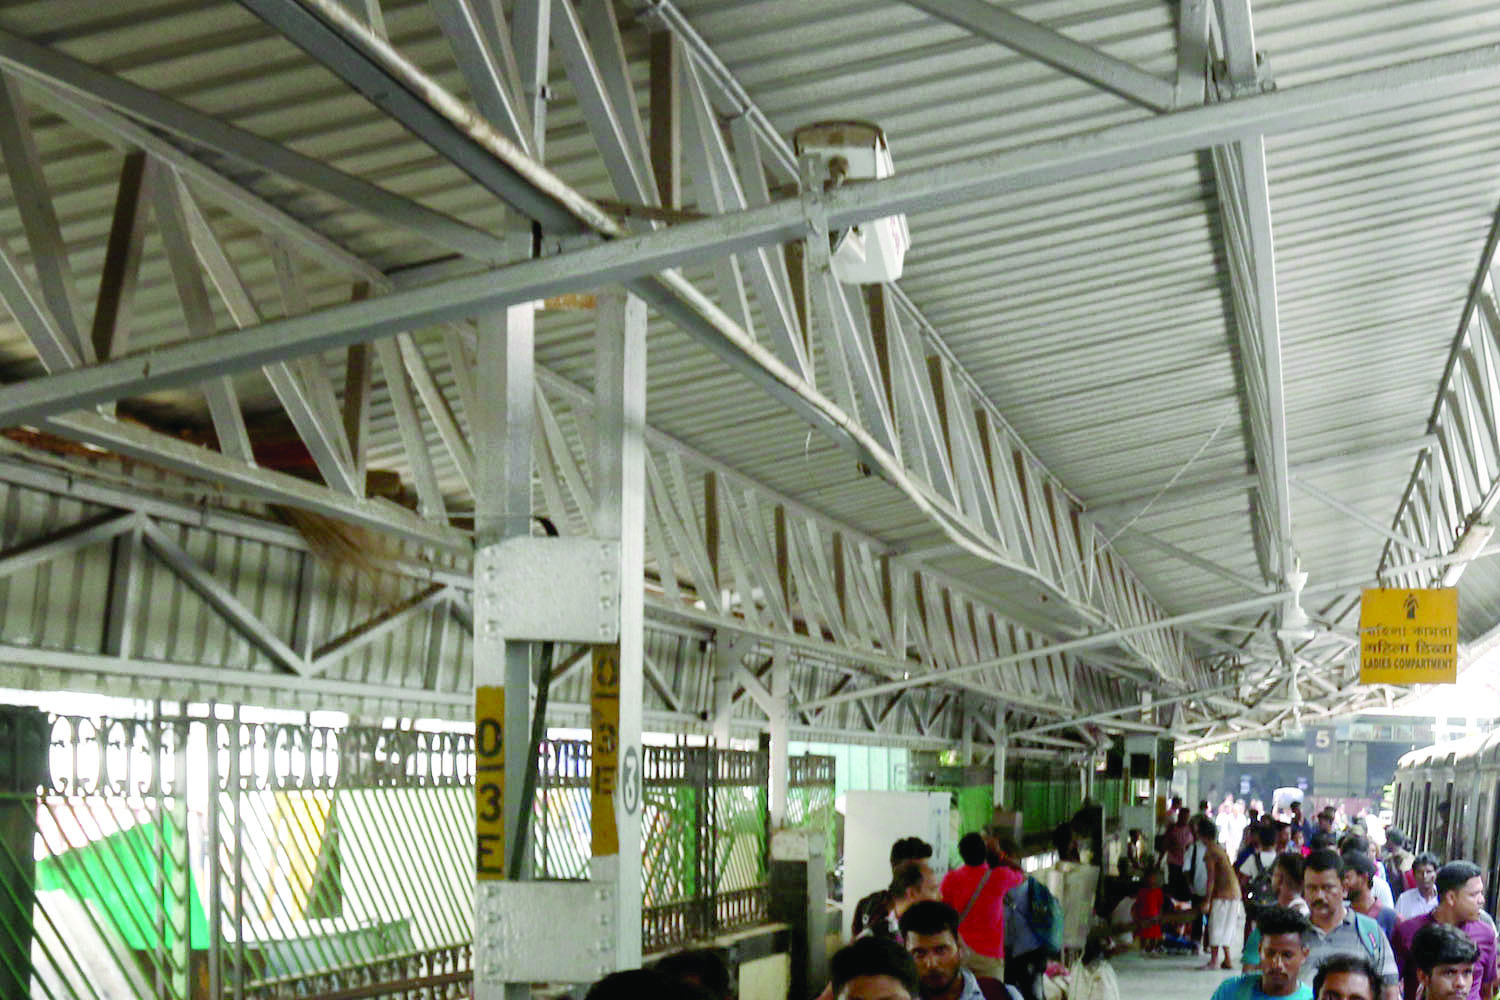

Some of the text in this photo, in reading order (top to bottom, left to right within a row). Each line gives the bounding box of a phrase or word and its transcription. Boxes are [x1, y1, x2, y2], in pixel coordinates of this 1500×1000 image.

[1363, 657, 1453, 670] LADIES COMPARTMENT
[1315, 729, 1330, 749] 5
